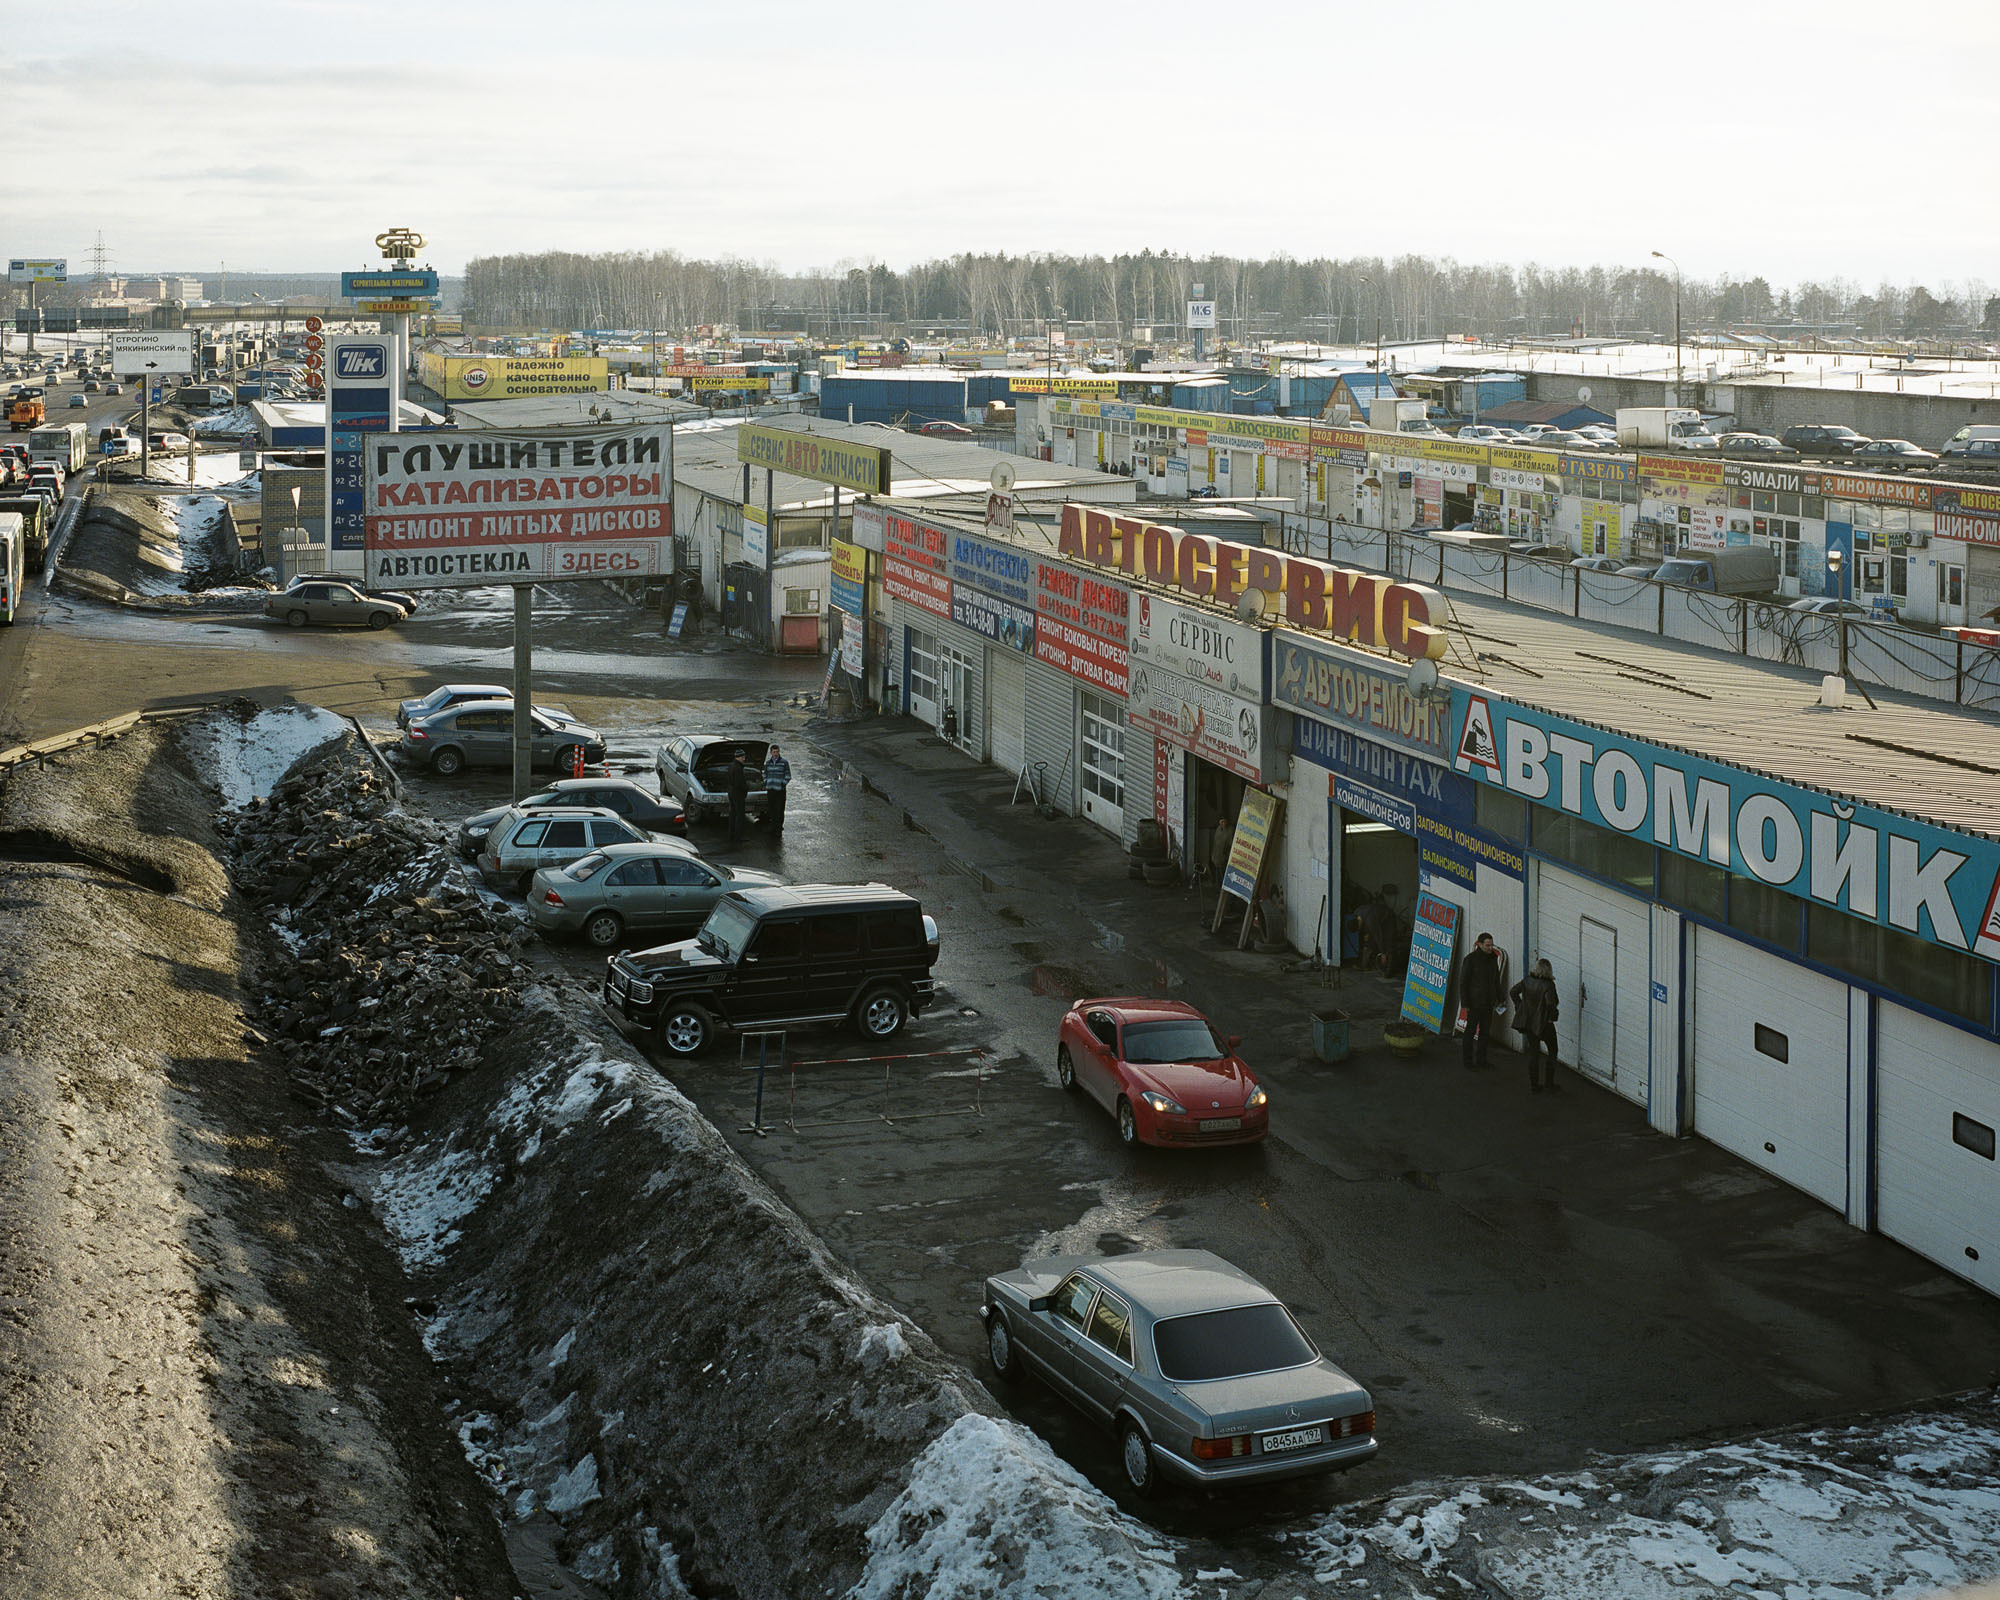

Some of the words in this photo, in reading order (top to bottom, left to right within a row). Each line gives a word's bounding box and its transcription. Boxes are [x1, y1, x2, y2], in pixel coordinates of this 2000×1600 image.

[352, 279, 391, 288] СТРОИТЕЛЬНЫЕ
[391, 279, 424, 287] МАТЕРИАЛЫ
[308, 321, 320, 329] 24
[115, 344, 176, 352] МЯКИНИНСКИЙ
[506, 361, 564, 370] надежно
[463, 373, 485, 382] UNIS
[506, 374, 590, 382] качественно
[1012, 378, 1115, 388] ПИЛОМАТЕРИАЛЫ
[506, 385, 598, 394] основательно
[1227, 420, 1300, 441] АВТОСЕРВИС
[1312, 430, 1332, 443] СХОД
[1335, 432, 1363, 445] РАЗВАЛ
[1264, 445, 1289, 457] РЕМОНТ
[1313, 445, 1340, 458] РЕМОНТ
[1367, 435, 1421, 450] АВТОСЕРВИС
[1430, 442, 1480, 456] АККУМУЛЯТОРЫ
[377, 437, 661, 477] ГЛУШИТЕЛИ
[750, 434, 784, 464] СЕРВИС
[784, 439, 819, 474] АВТО
[820, 448, 876, 486] ЗАПЧАСТИ
[1639, 456, 1723, 475] АВТОЗАПЧАСТИ
[335, 477, 345, 485] 92
[1570, 460, 1625, 481] ГАЗЕЛЬ
[1724, 466, 1741, 475] HELIOS
[1724, 476, 1739, 486] VIKA
[1741, 469, 1799, 491] ЭМАЛИ
[378, 473, 661, 507] КАТАЛИЗАТОРЫ
[1836, 478, 1915, 500] ИНОМАРКИ
[1870, 496, 1913, 506] АВТОЗАПЧАСТИ
[378, 517, 473, 541] РЕМОНТ
[480, 513, 563, 537] ЛИТЫХ
[570, 508, 662, 537] ДИСКОВ
[886, 515, 947, 556] ГЛУШИТЕЛИ
[378, 551, 531, 577] АВТОСТЕКЛА
[561, 552, 640, 573] ЗДЕСЬ
[836, 546, 851, 563] ДОБРО
[955, 537, 1029, 584] АВТОСТЕКЛО
[1037, 563, 1080, 600] РЕМОНТ
[1081, 578, 1128, 619] ДИСКОВ
[1057, 503, 1448, 659] АВТОСЕРВИС
[886, 578, 949, 616] ЭКСПРЕСС-ИЗГОТОВЛЕНИЕ
[954, 605, 965, 621] ТЕЛ.
[1003, 602, 1012, 618] БЕЗ
[1037, 593, 1127, 641] ШИНОМОНТАЖ
[1178, 611, 1220, 630] ОФИЦИАЛЬНЫЙ
[1038, 616, 1064, 640] РЕМОНТ
[1064, 627, 1098, 655] БОКОВЫХ
[1099, 640, 1130, 667] ПОРЕЗО
[1170, 618, 1234, 664] СЕРВИС
[1037, 641, 1067, 666] АРГОННО
[1071, 655, 1103, 682] ДУГОВАЯ
[1104, 669, 1130, 694] СВАРК
[1206, 666, 1223, 682] Audi
[1151, 669, 1234, 722] ШИНОМОНТАЖ
[1304, 655, 1447, 748] АВТОРЕМОНТ
[1205, 714, 1233, 739] ДИСКОВ
[1337, 787, 1411, 831] КОНДИЦИОНЕРОВ
[1417, 815, 1453, 841] ЗАПРАВКА
[1455, 830, 1523, 872] КОНДИЦИОНЕРОВ
[1422, 848, 1474, 882] БАЛАНСИРОВКА
[1418, 896, 1456, 929] АКЦИЯ!
[1414, 919, 1452, 948] ШИНОМОНТАЖ
[1411, 944, 1449, 973] БЕСПЛАТНАЯ
[1409, 961, 1429, 983] МОЙКА
[1428, 971, 1444, 989] АВТО
[1304, 1430, 1319, 1442] 197
